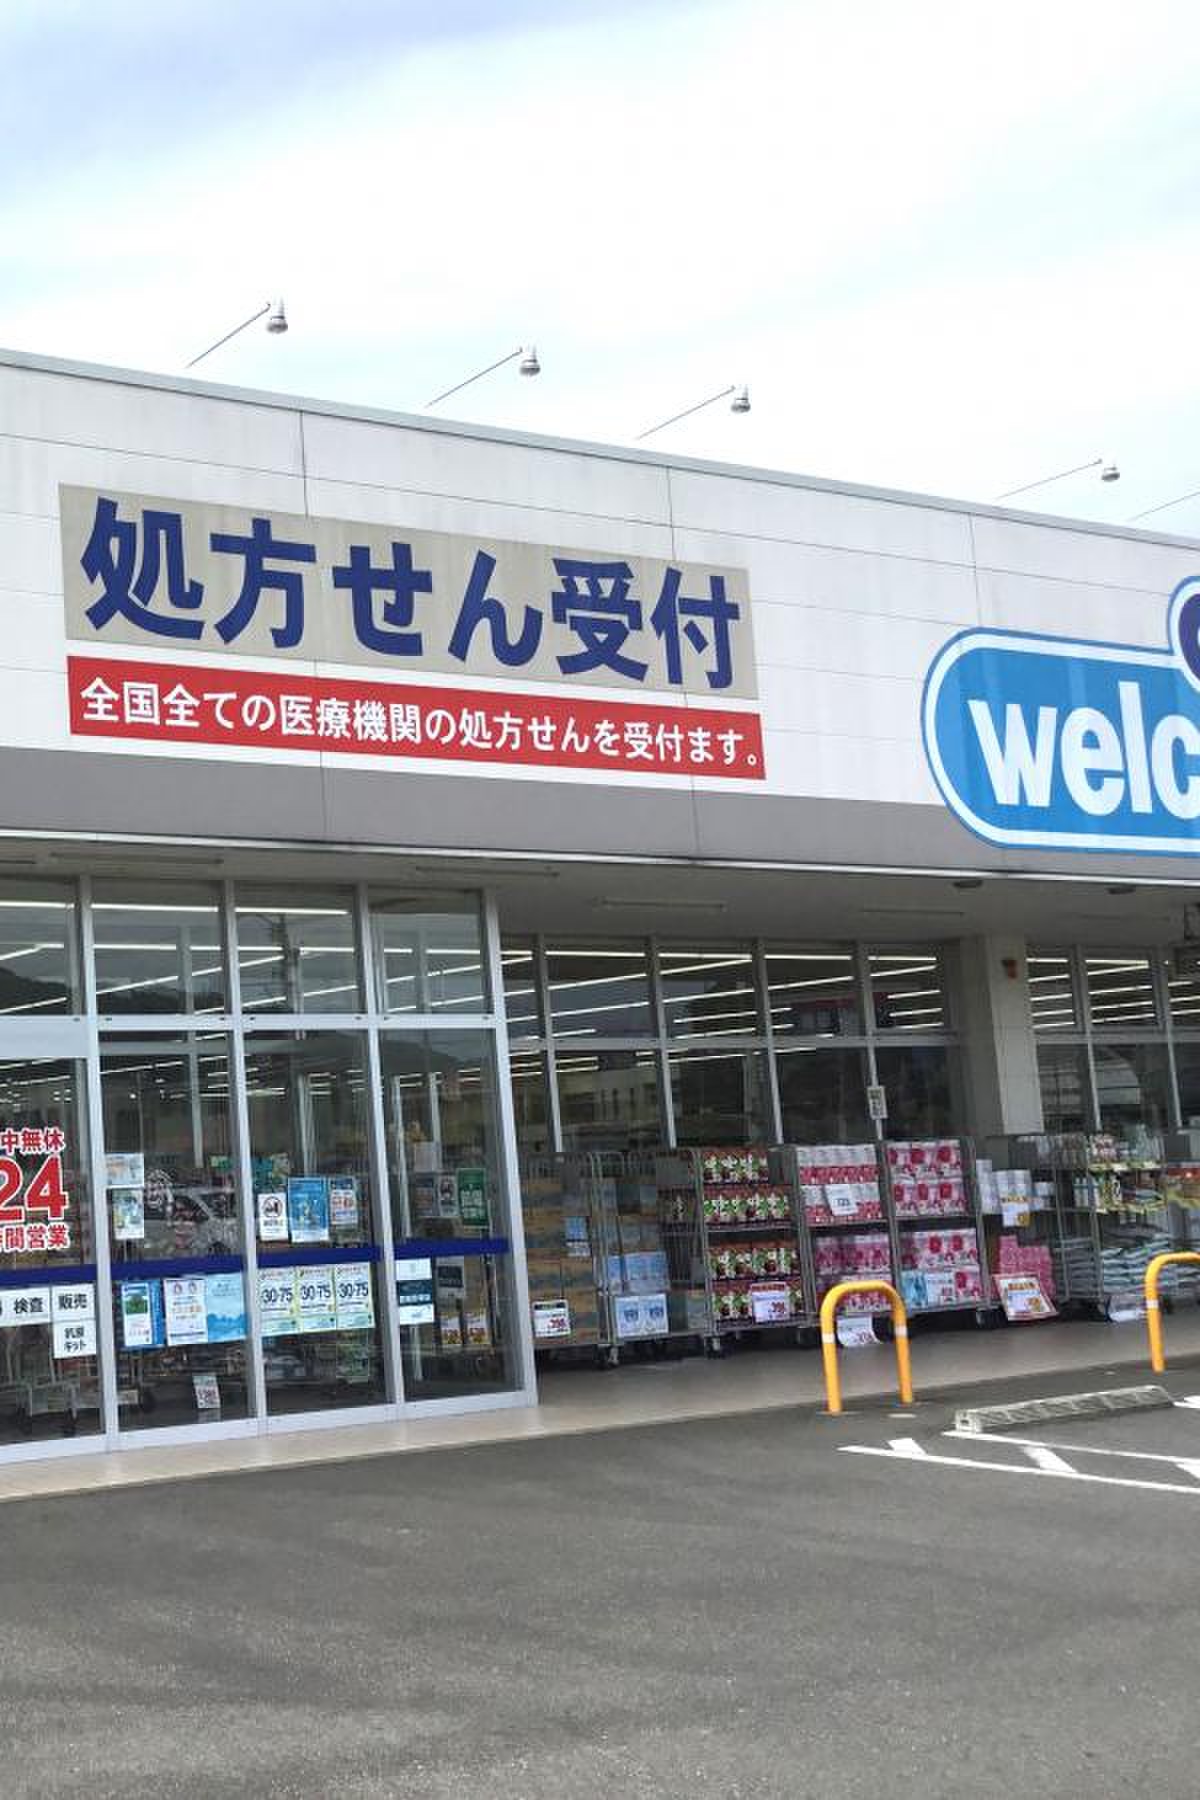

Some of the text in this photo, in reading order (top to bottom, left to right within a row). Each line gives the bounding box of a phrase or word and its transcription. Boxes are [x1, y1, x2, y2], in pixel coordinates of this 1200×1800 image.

[80, 496, 740, 689] 処方せん受付
[80, 677, 758, 768] 全国全ての医療機関の処方せんを受付ます。
[13, 1297, 44, 1315] 検査
[58, 1294, 87, 1310] 販売
